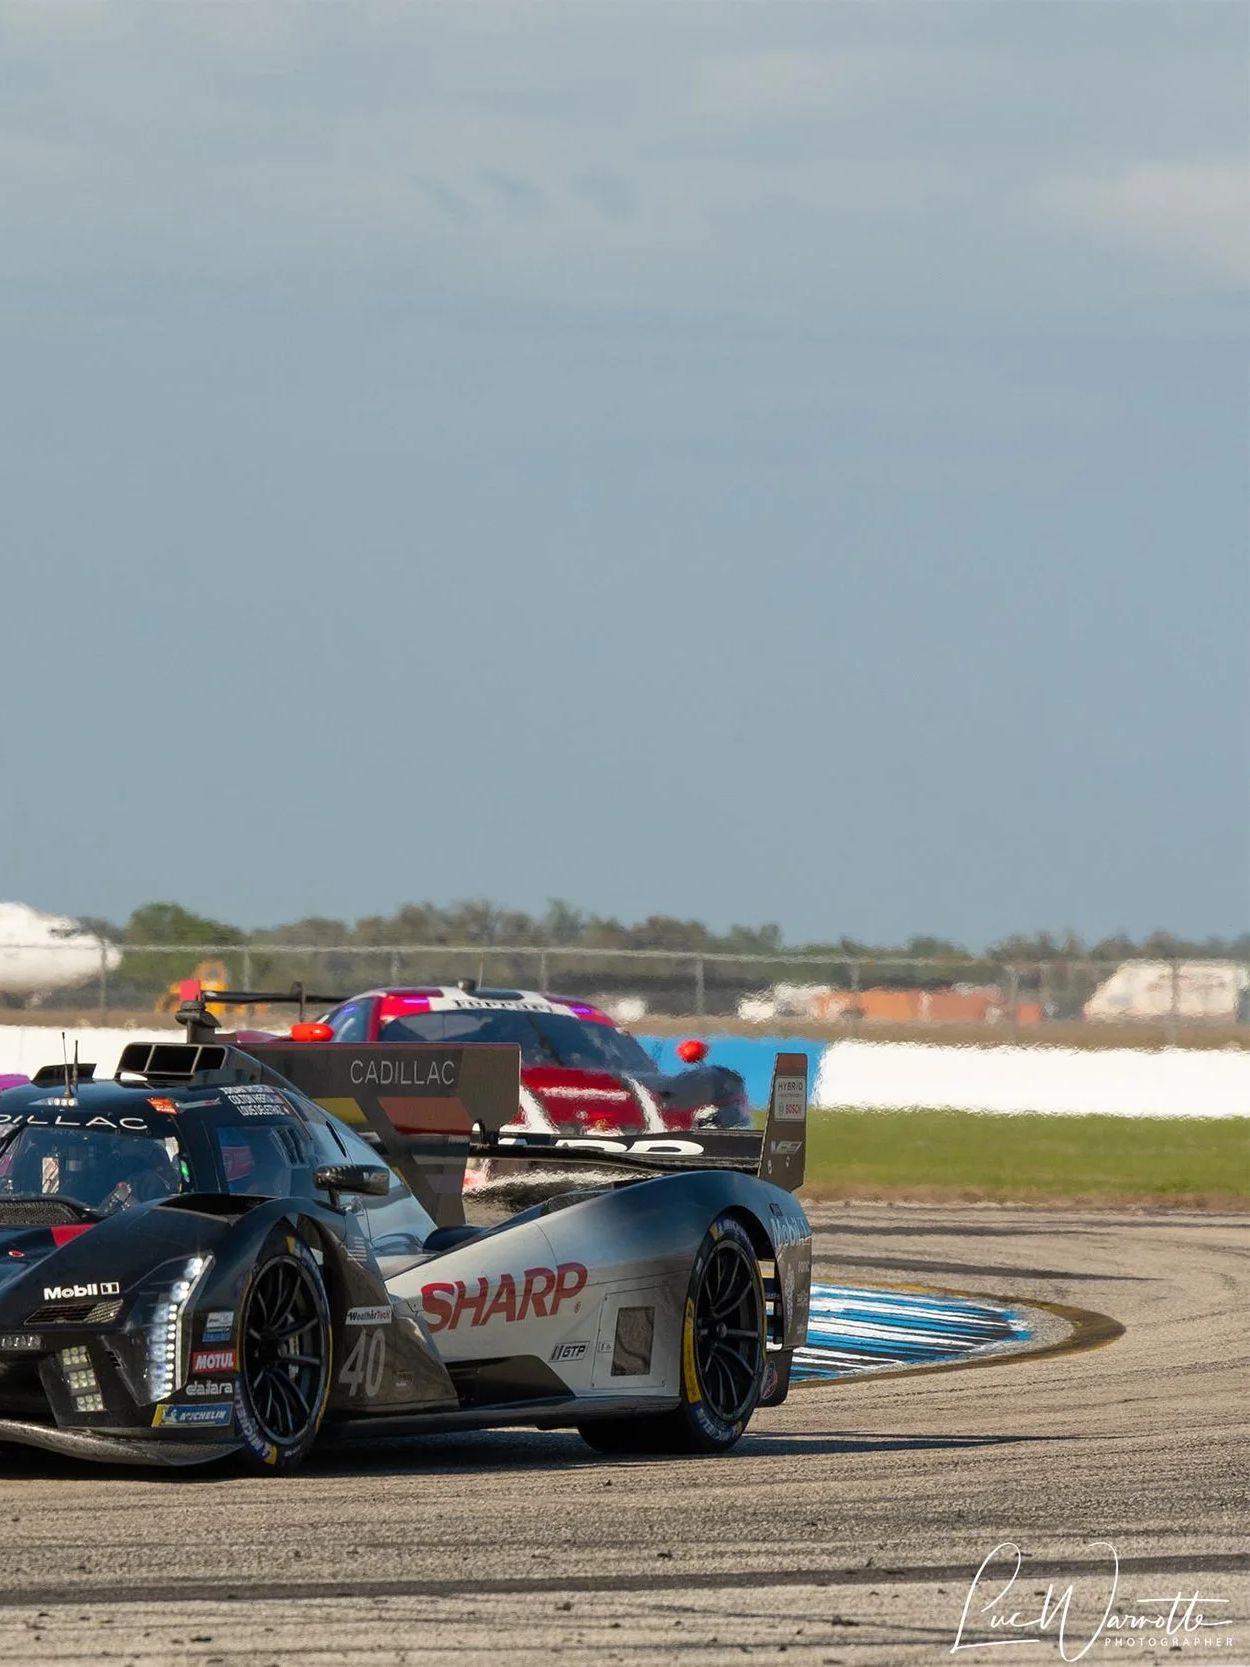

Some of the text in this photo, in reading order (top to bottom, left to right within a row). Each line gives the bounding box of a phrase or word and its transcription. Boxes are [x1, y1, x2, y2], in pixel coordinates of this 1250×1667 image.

[350, 1060, 455, 1085] CADILLAC
[43, 1281, 120, 1301] Mobil 1
[421, 1262, 589, 1333] SHARP
[196, 1352, 234, 1370] MOTUL
[338, 1327, 386, 1398] 40
[186, 1380, 234, 1396] dallara
[180, 1410, 227, 1421] MICHELIN
